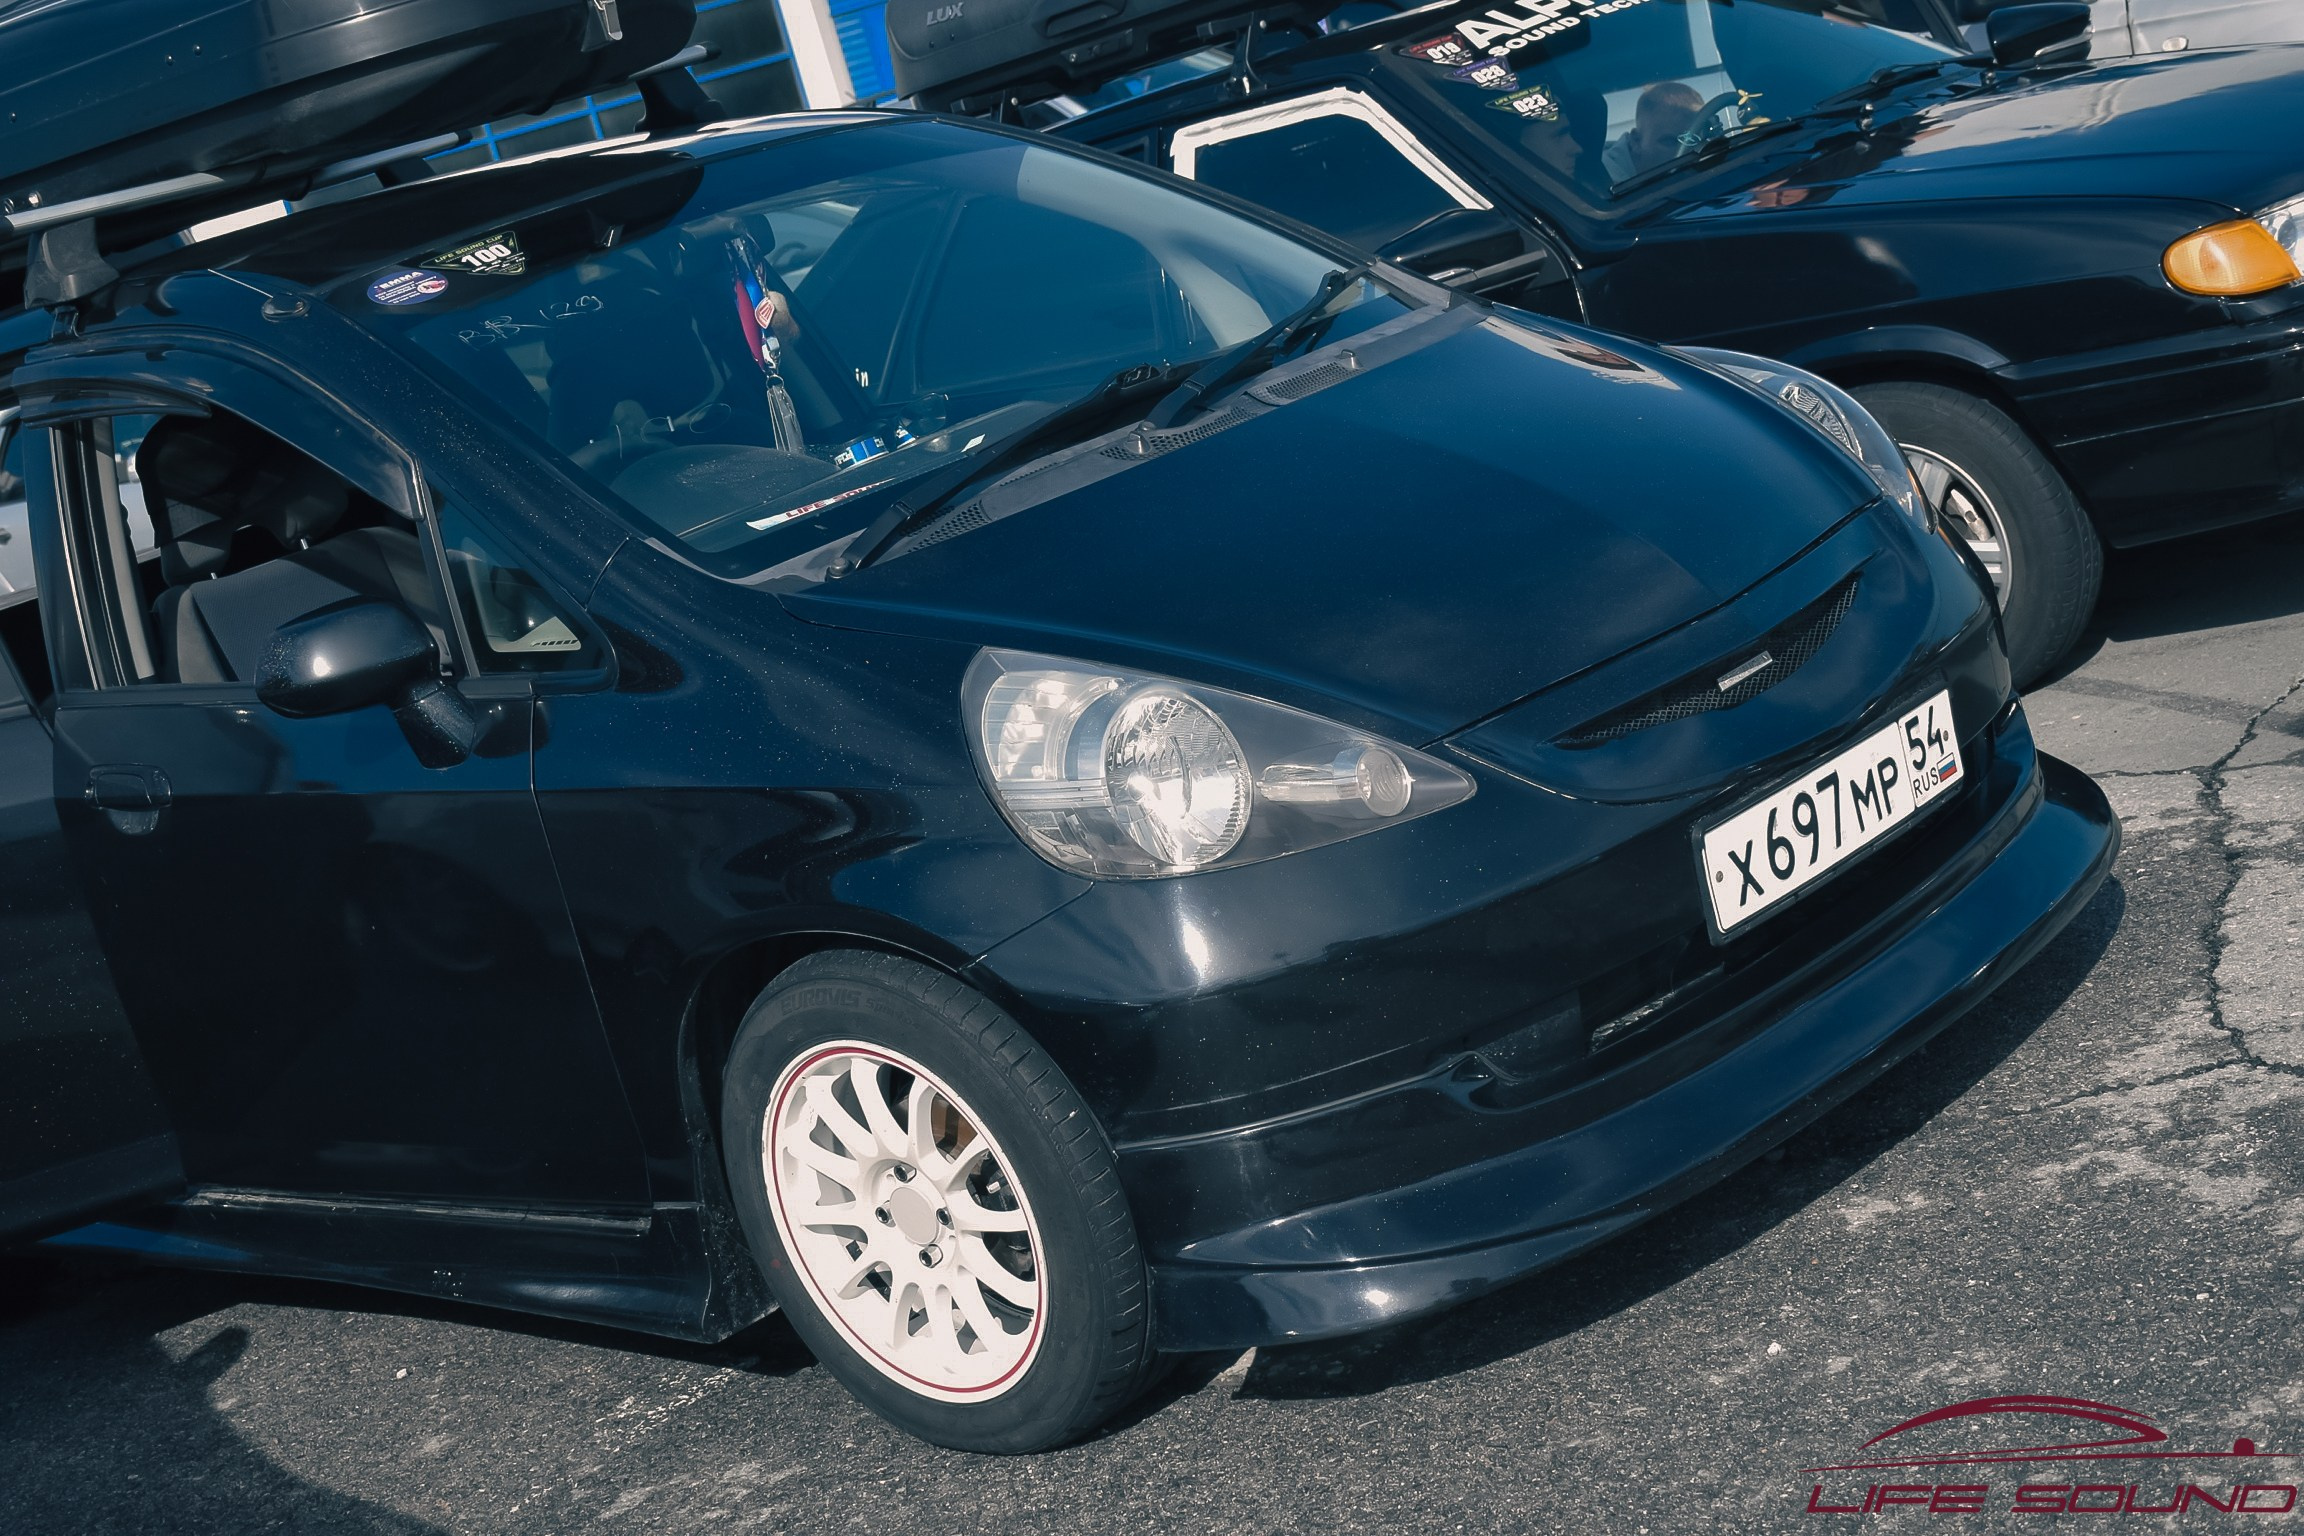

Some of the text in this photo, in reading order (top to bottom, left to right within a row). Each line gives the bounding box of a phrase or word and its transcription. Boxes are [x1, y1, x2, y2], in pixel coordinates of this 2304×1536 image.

[926, 1, 964, 26] LUX
[1455, 0, 1595, 49] ALP
[1488, 17, 1581, 57] SOUND
[1512, 94, 1549, 113] 023
[434, 252, 455, 263] LIFE
[455, 241, 485, 255] SOUND
[486, 234, 503, 245] CUP
[461, 244, 512, 267] 100
[379, 271, 424, 290] EMMA
[785, 500, 827, 519] LIFE
[1903, 704, 1945, 771] 54
[1912, 766, 1940, 799] RUS
